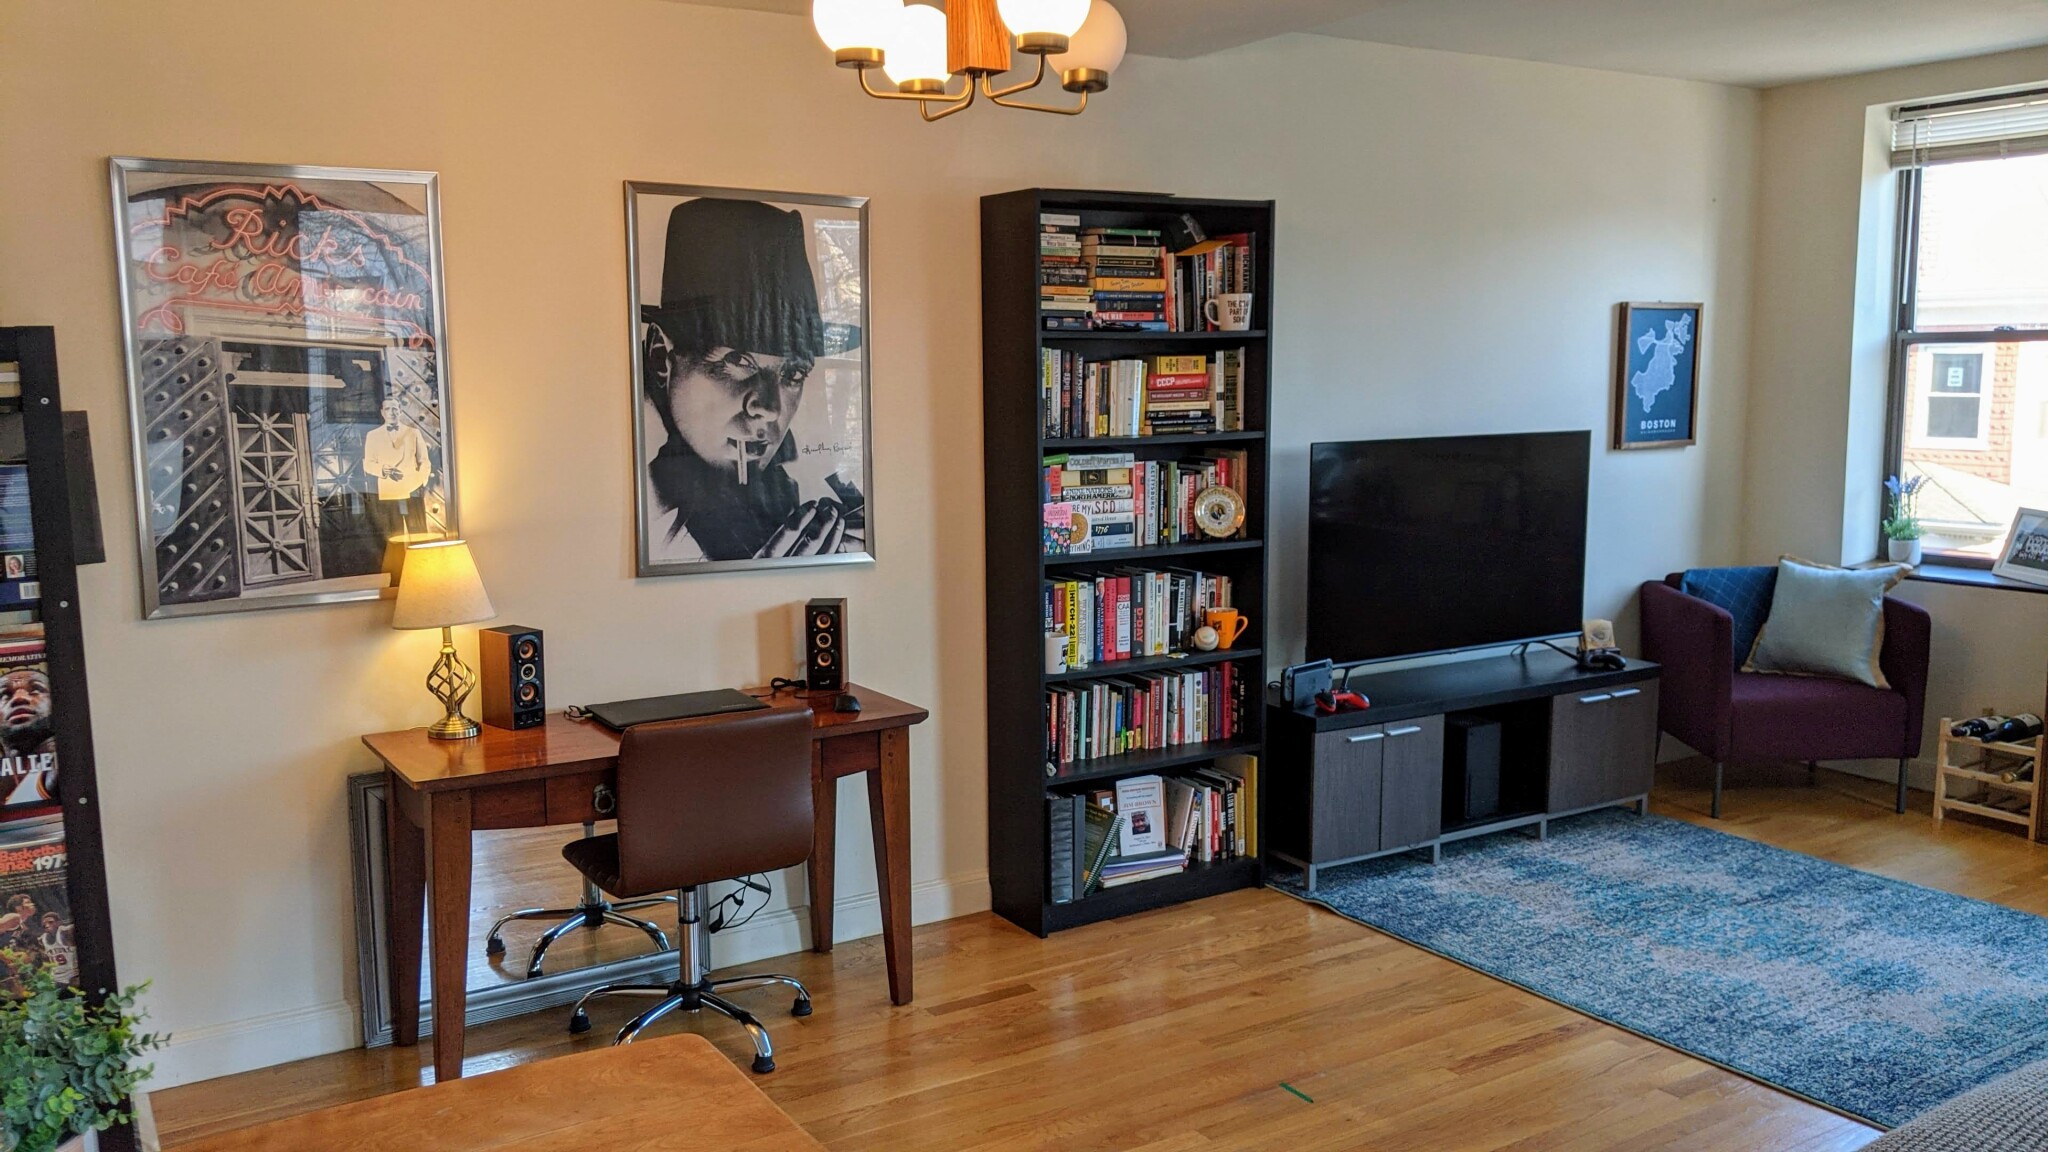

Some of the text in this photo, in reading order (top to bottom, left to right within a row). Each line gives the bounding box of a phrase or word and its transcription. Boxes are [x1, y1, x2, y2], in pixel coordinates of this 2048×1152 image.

[212, 207, 366, 269] Rick's
[147, 246, 240, 295] Café
[1242, 247, 1250, 294] UCKRAKIN
[1156, 376, 1176, 388] CCCP
[1640, 418, 1677, 430] BOSTON
[1082, 505, 1092, 516] MY
[1095, 525, 1109, 534] 1776
[1123, 800, 1157, 809] JIM BROWN
